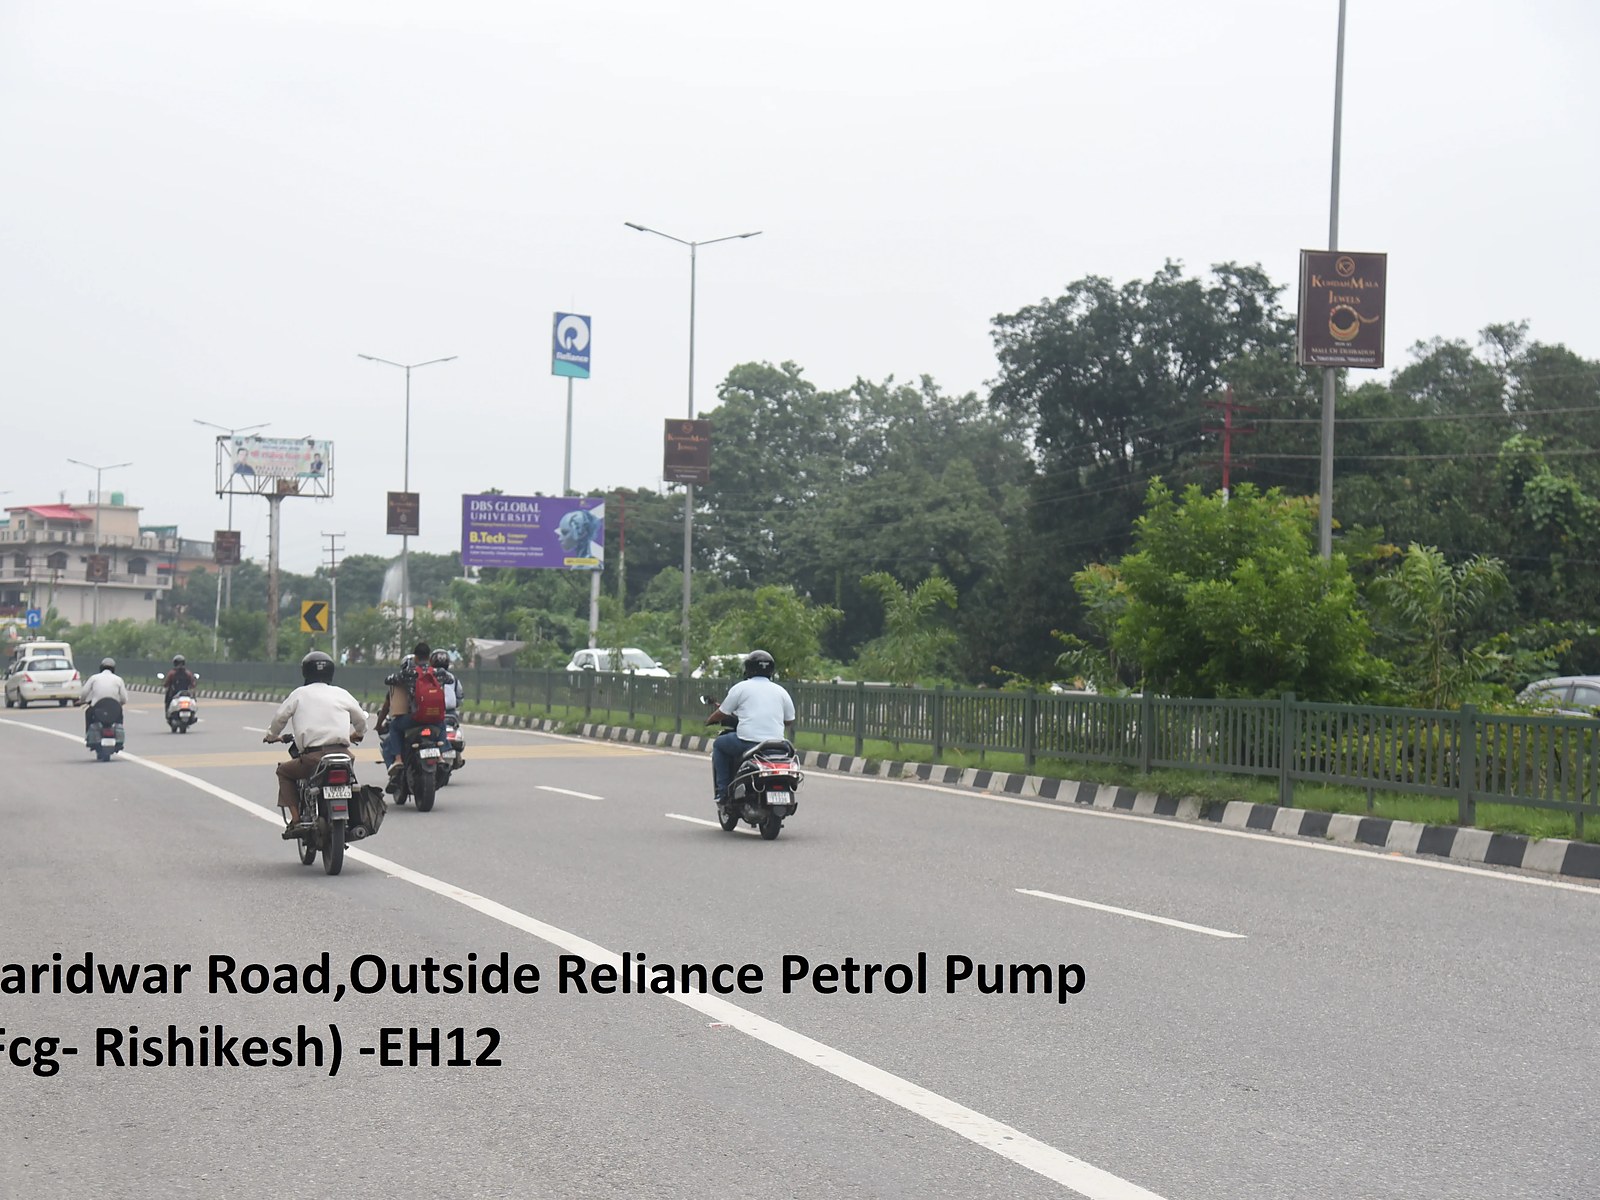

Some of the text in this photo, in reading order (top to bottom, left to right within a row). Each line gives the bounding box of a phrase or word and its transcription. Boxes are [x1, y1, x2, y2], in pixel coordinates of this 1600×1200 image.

[470, 500, 541, 513] DBS GLOBAL
[470, 512, 540, 522] UNIVERSITY
[469, 531, 506, 544] B.Tech
